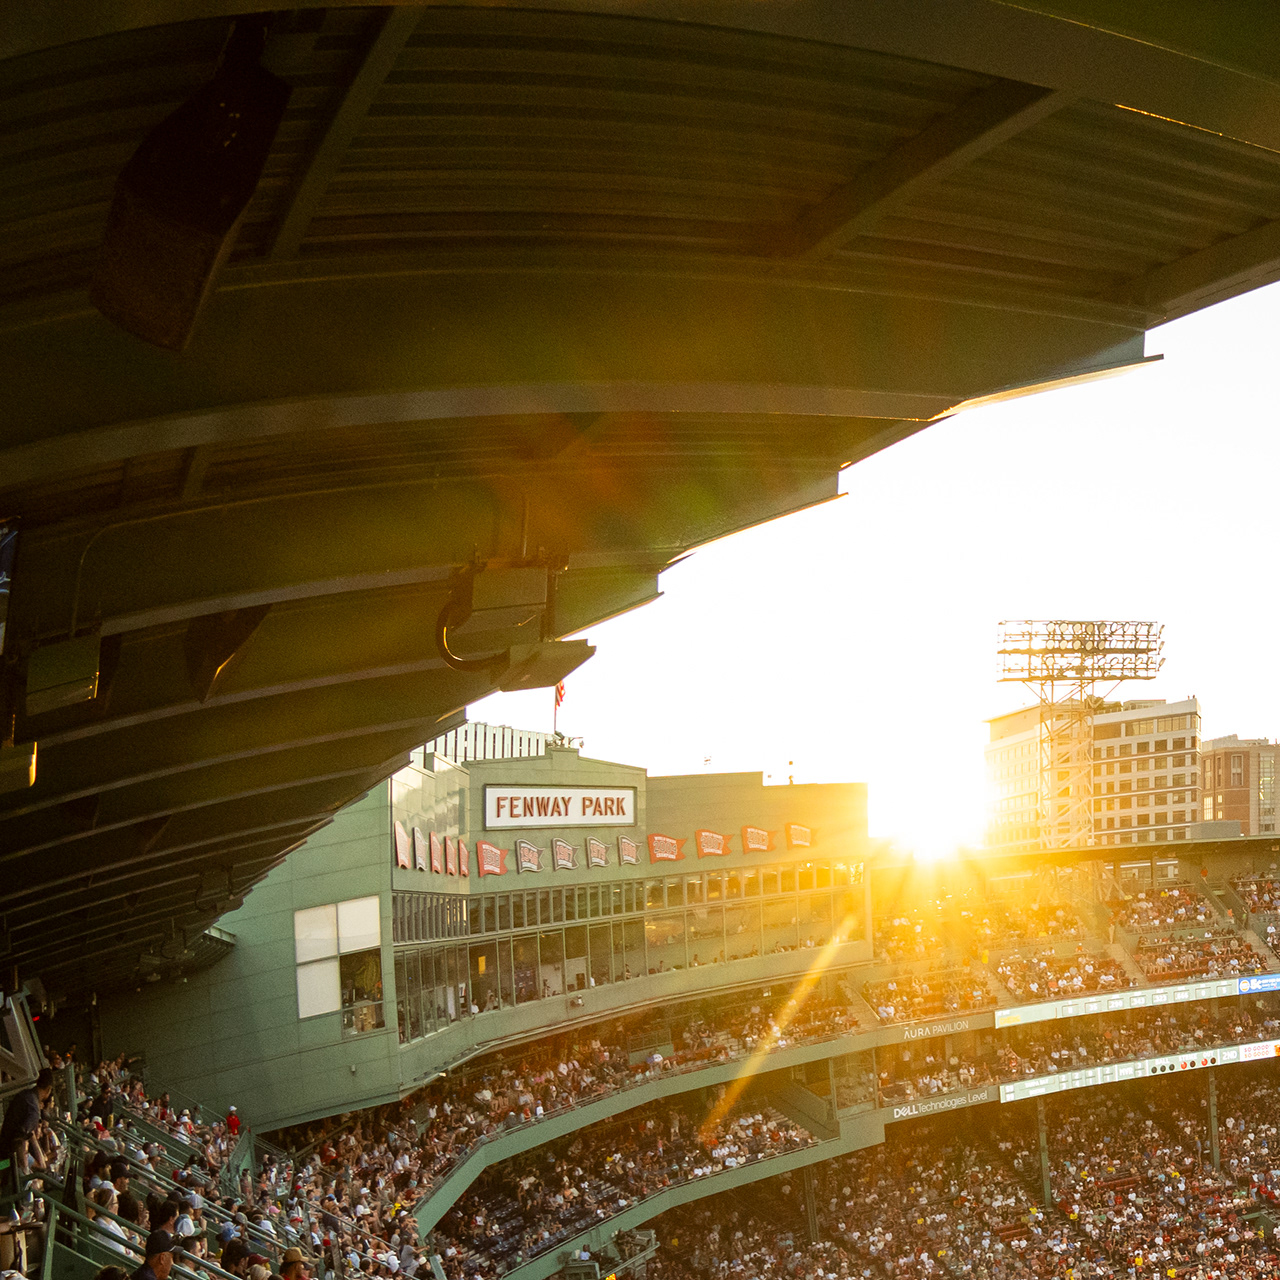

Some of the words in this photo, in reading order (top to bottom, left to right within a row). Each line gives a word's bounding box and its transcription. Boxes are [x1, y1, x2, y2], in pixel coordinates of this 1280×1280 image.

[496, 796, 572, 818] FENWAY
[582, 796, 626, 816] PARK
[653, 840, 678, 855] 2004
[932, 1020, 969, 1034] PAVILION
[918, 1096, 966, 1114] Technologies
[968, 1090, 988, 1104] Level
